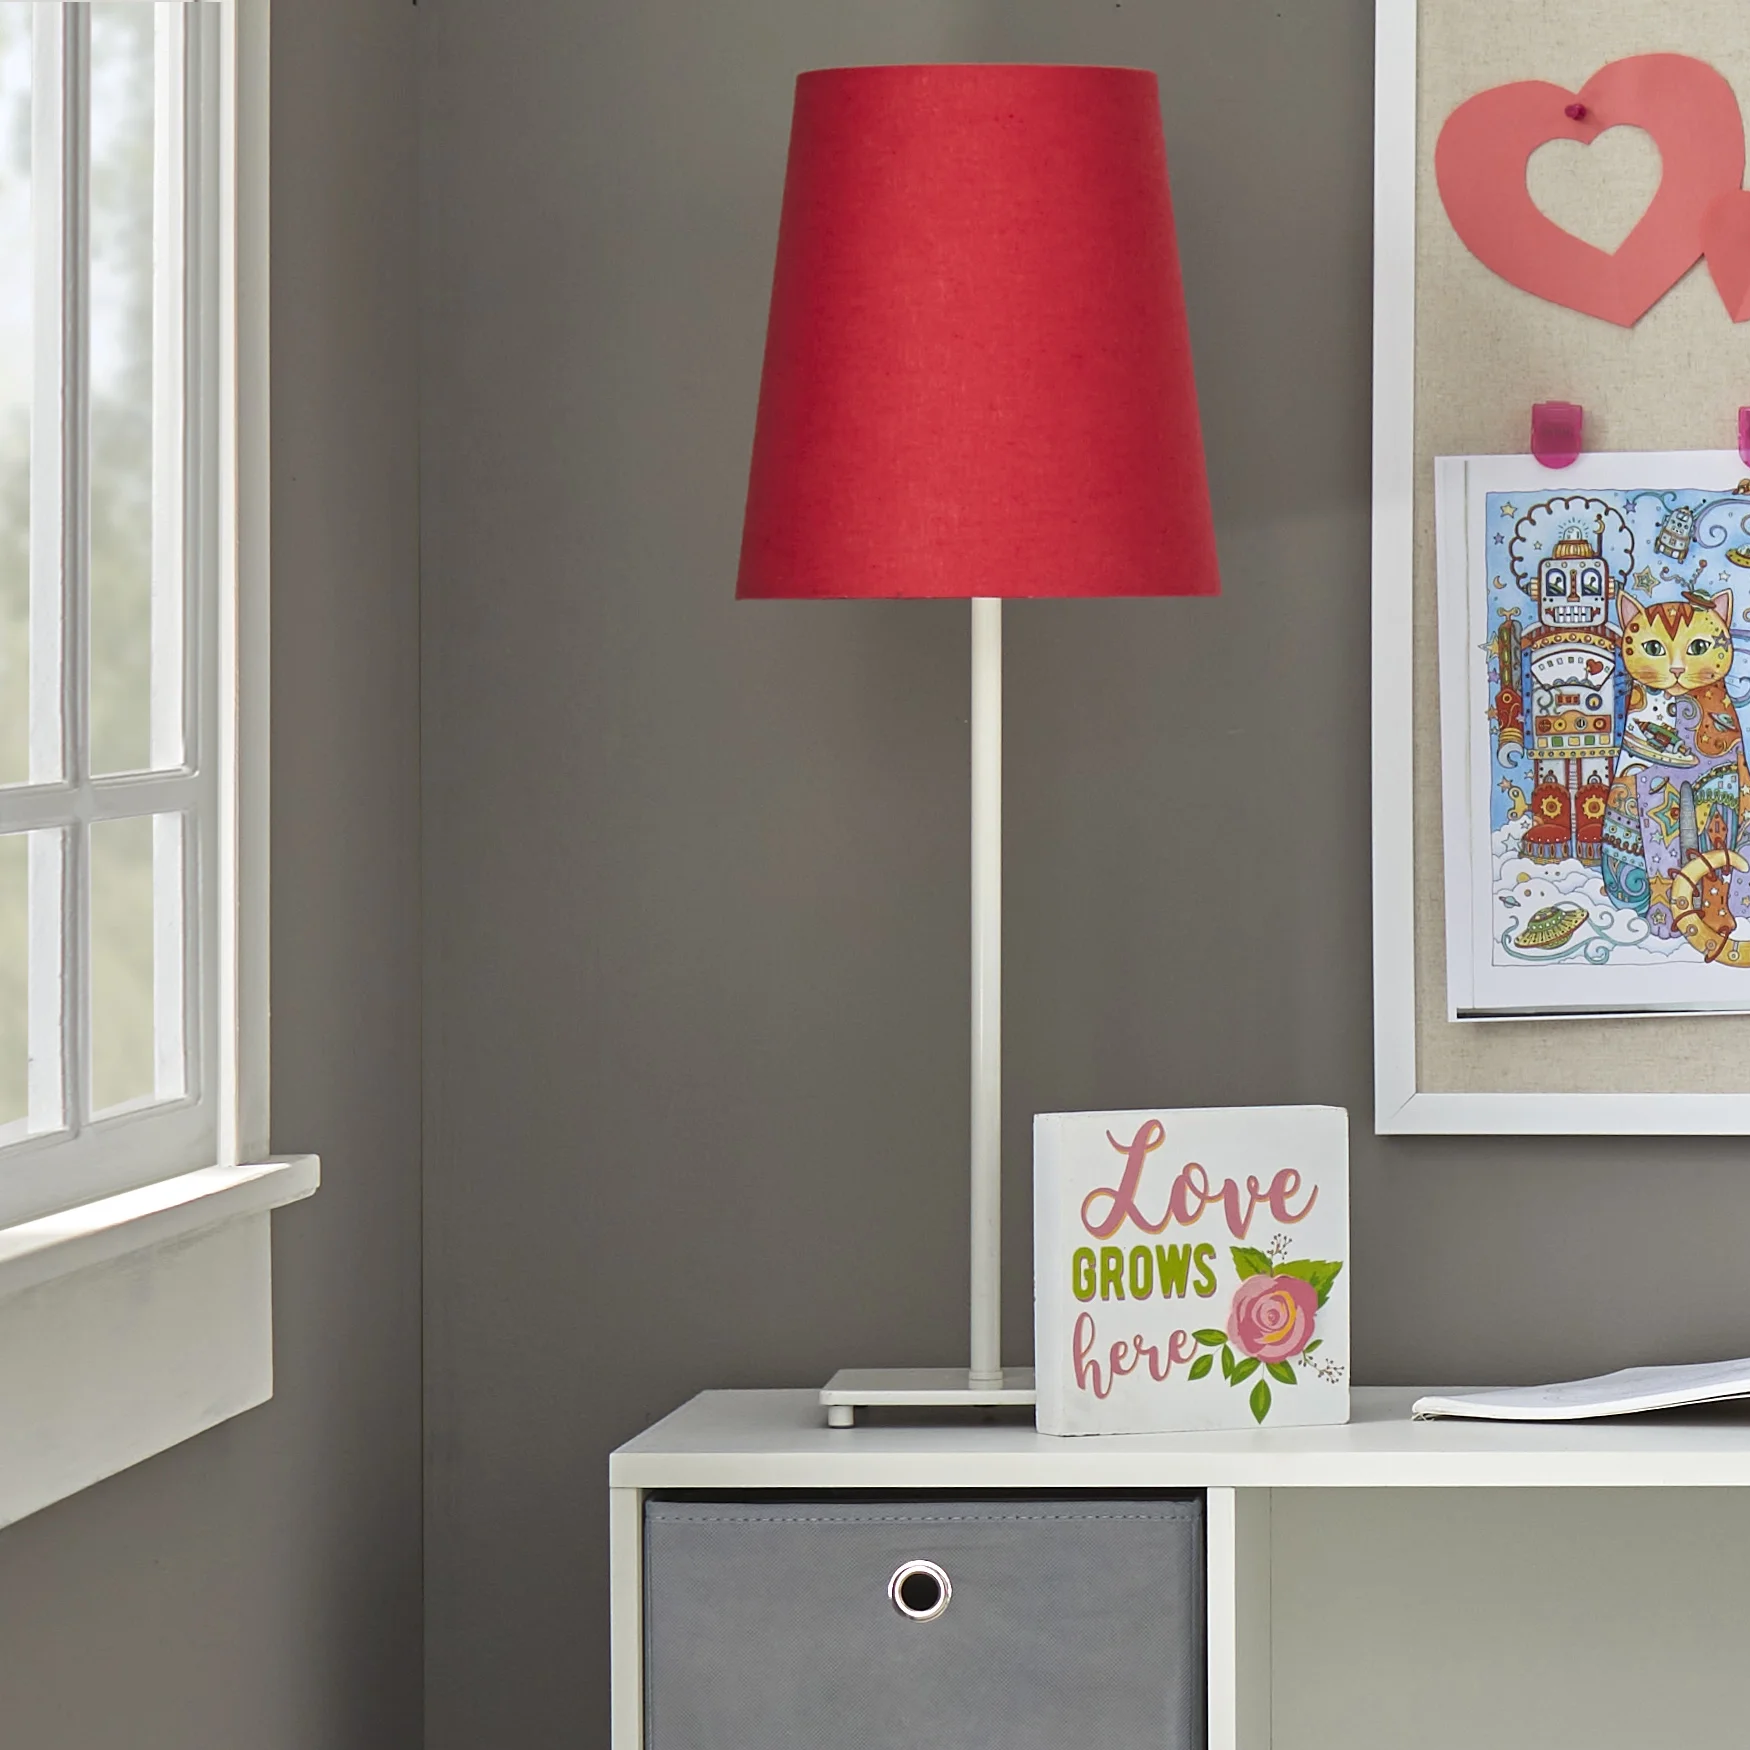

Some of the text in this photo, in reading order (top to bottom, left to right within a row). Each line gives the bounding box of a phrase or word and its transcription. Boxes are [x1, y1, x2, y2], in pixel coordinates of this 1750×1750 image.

[1081, 1119, 1319, 1240] Love
[1072, 1242, 1217, 1302] GROWS
[1072, 1312, 1198, 1400] here
